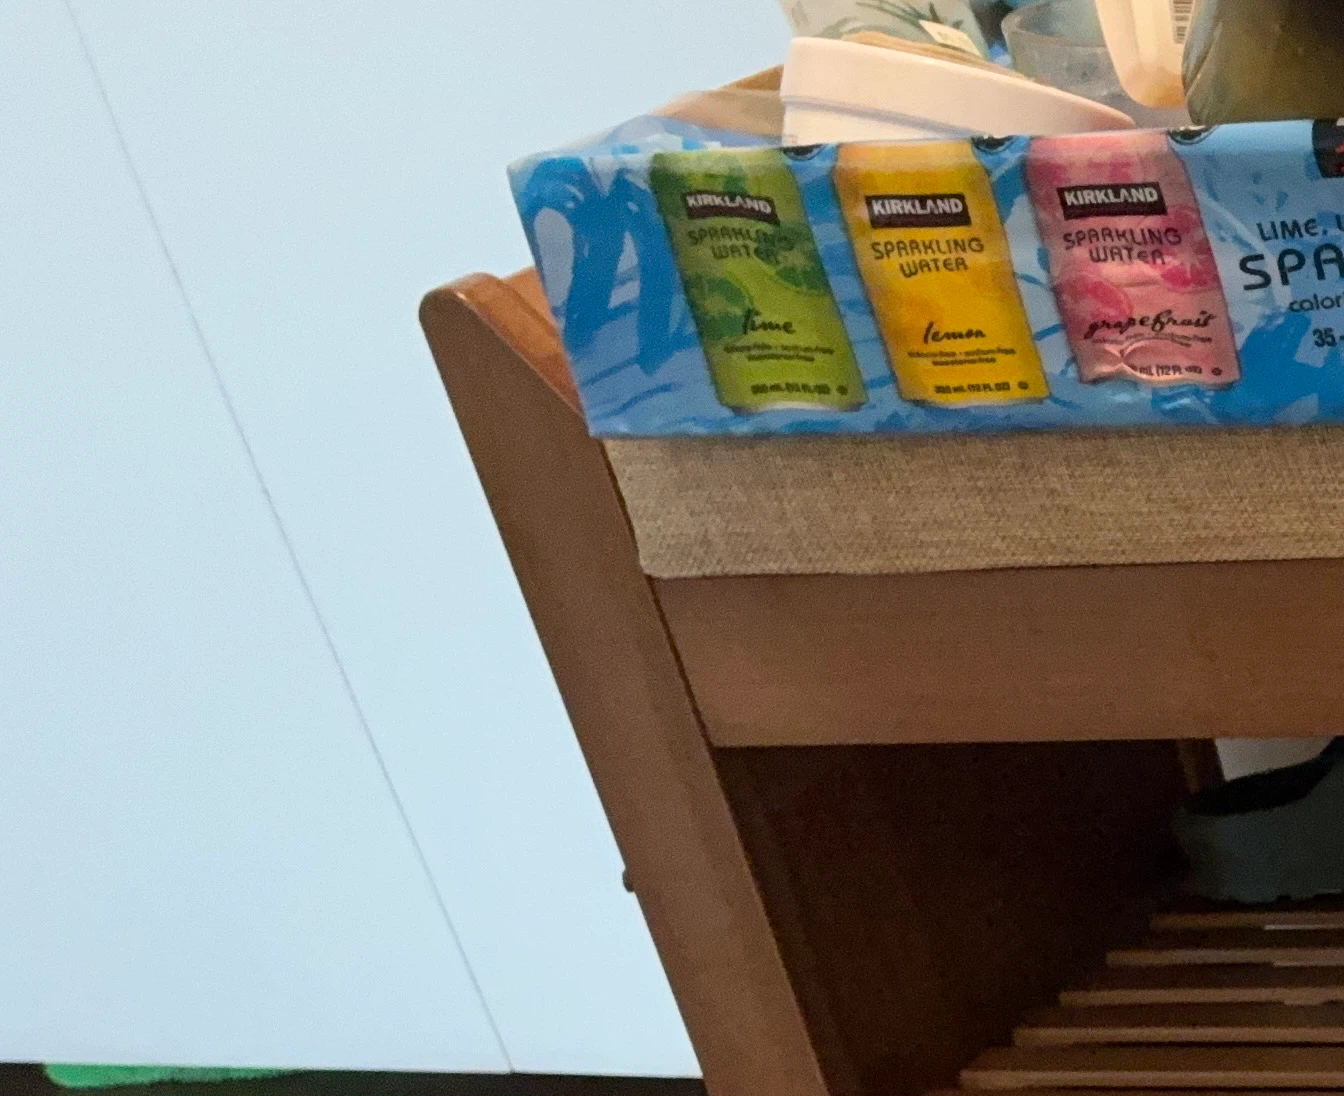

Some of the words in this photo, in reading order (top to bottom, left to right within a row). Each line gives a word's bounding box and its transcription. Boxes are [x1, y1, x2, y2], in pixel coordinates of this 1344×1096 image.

[685, 192, 773, 215] KIRKLAND
[871, 197, 964, 216] KIRKLAND
[1063, 186, 1159, 207] KIRKLAND
[870, 237, 984, 261] SPARKLING
[1062, 227, 1182, 251] SPARKLING
[1088, 245, 1166, 265] WATER
[899, 257, 969, 278] WATER
[923, 321, 987, 345] lemon
[1083, 309, 1217, 340] grapefruit
